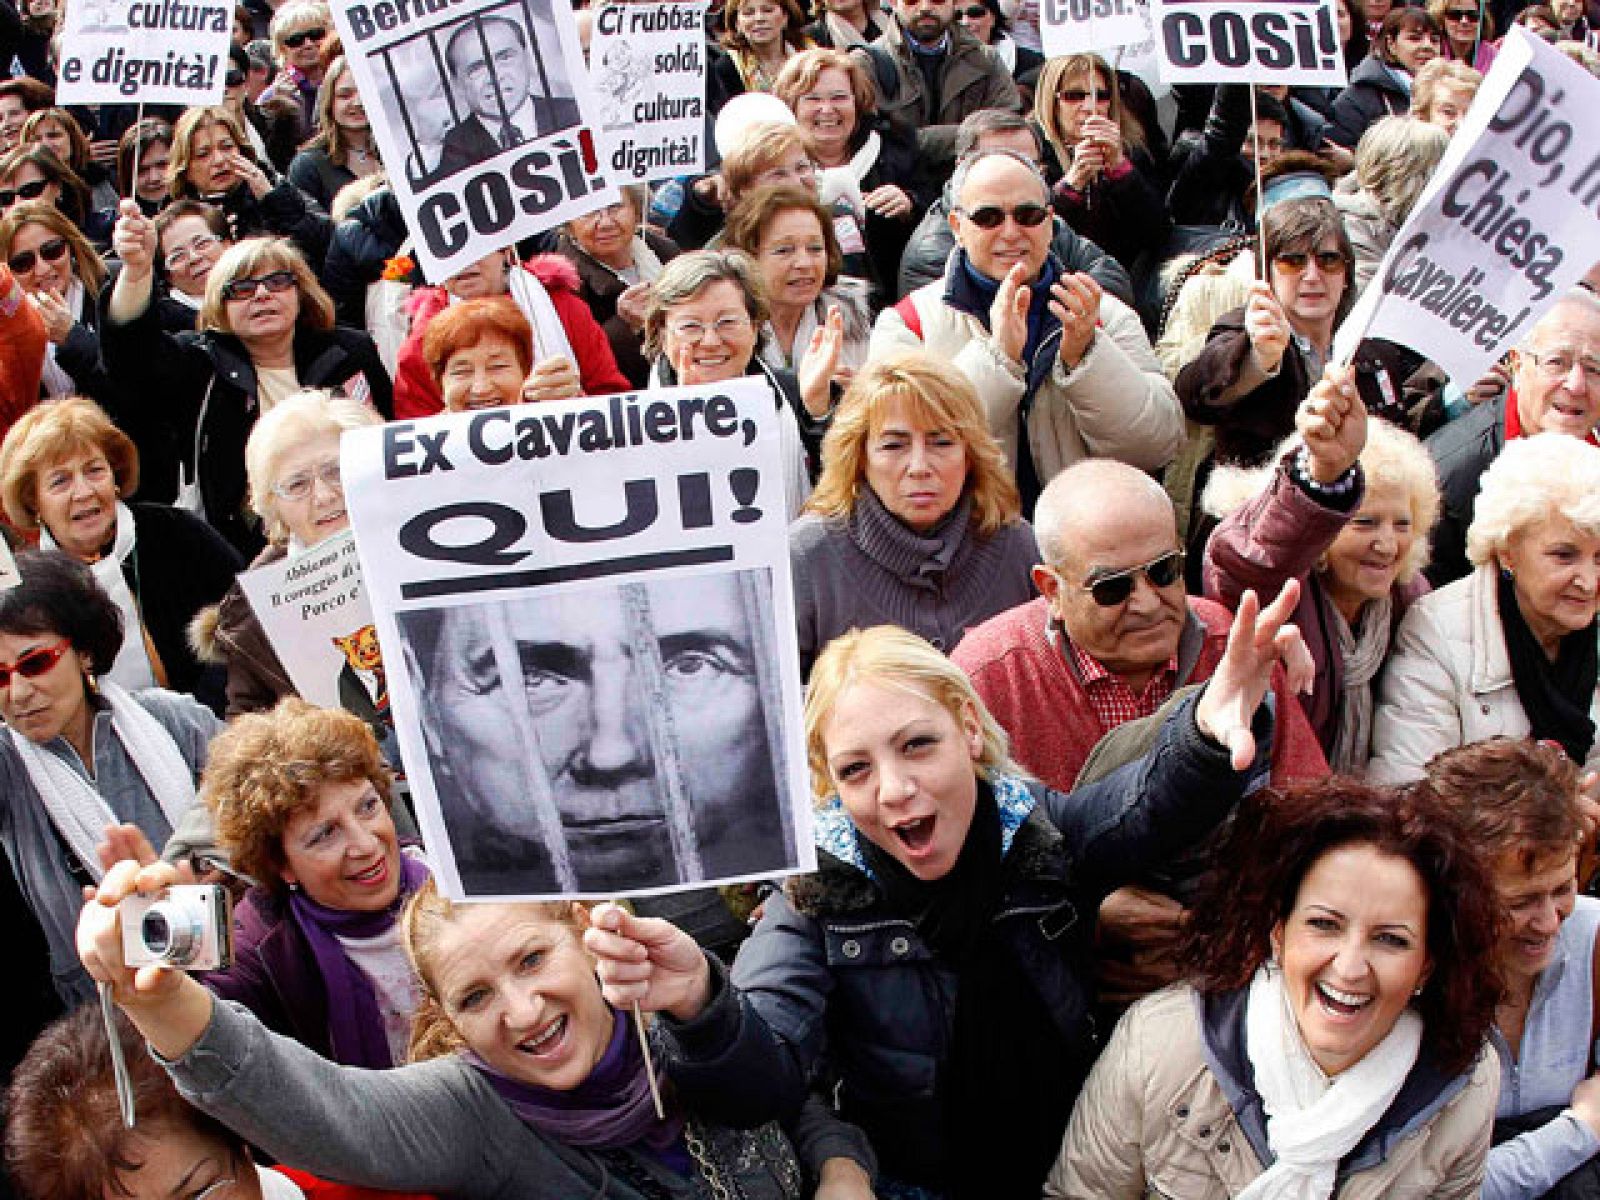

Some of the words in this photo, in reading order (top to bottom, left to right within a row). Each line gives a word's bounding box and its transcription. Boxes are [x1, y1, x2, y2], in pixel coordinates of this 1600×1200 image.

[128, 0, 228, 32] cultura
[598, 6, 626, 35] Ci
[630, 5, 701, 33] rubba:
[62, 57, 81, 83] e
[92, 47, 219, 95] dignità!
[655, 42, 704, 78] soldi,
[634, 92, 703, 124] cultura
[1487, 67, 1573, 188] Dio,
[612, 135, 698, 178] dignità!
[1441, 159, 1564, 301] Chiesa,
[1382, 232, 1531, 353] Cavaliere!
[383, 424, 455, 480] Ex
[467, 394, 758, 466] Cavaliere,
[399, 467, 763, 566] QUI!
[302, 592, 346, 620] Porco
